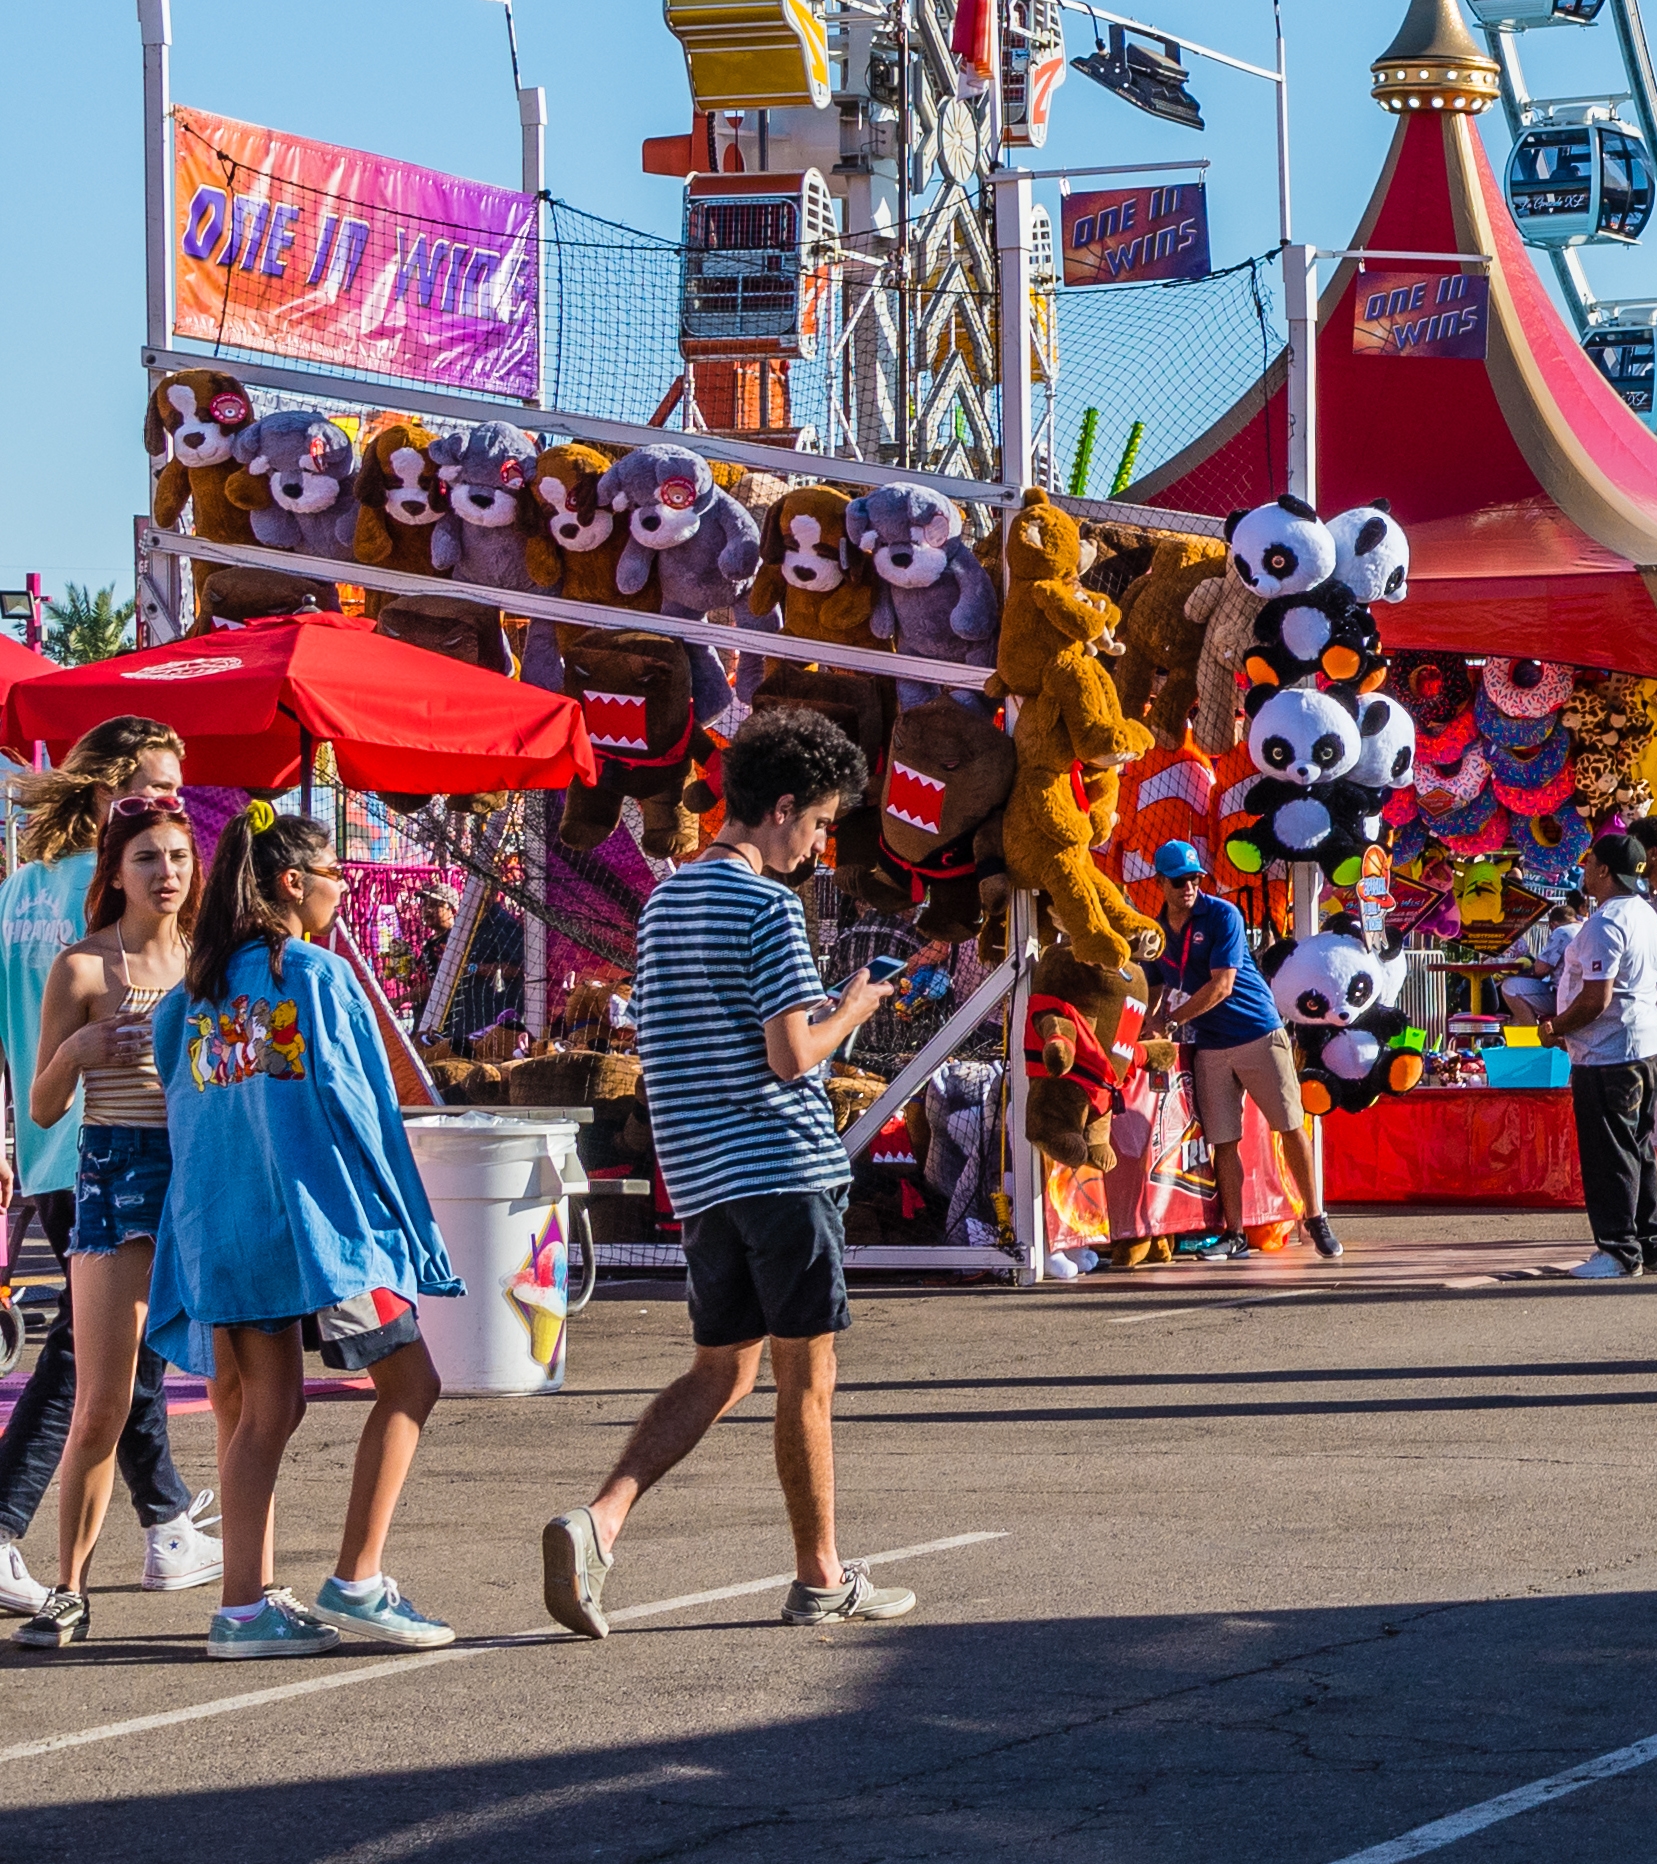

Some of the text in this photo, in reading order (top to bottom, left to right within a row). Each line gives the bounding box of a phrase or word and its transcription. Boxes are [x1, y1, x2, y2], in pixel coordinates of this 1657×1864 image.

[1072, 185, 1183, 249] ONE IN
[1565, 196, 1585, 208] XL
[181, 183, 299, 279] ONE
[1104, 217, 1197, 277] WINS
[1363, 274, 1469, 322] ONE IN
[1392, 305, 1478, 350] WINS
[1627, 392, 1647, 406] XL
